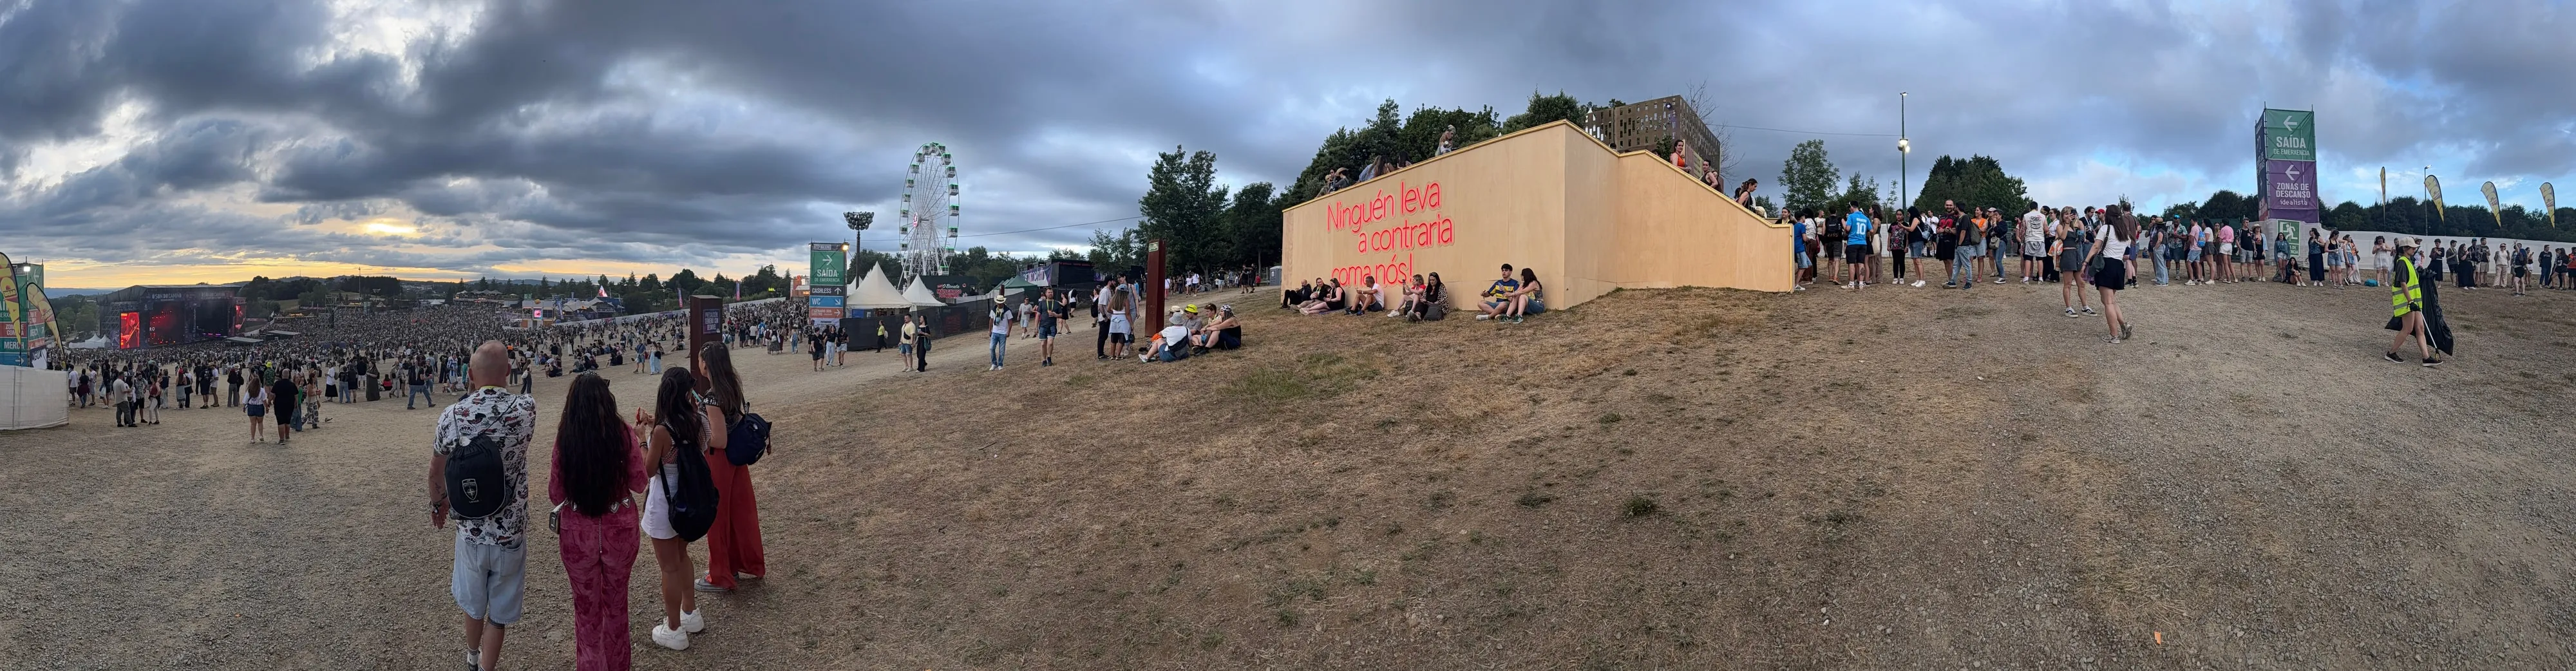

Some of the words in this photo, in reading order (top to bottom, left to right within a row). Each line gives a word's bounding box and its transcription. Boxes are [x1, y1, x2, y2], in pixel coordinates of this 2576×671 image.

[2276, 135, 2306, 148] SAÍDA
[2277, 183, 2298, 191] ZONAS
[1327, 189, 1395, 233] Ninguén
[1400, 180, 1441, 216] leva
[1358, 232, 1367, 254] a
[1370, 213, 1453, 251] contraria
[1856, 222, 1866, 235] 10
[817, 268, 838, 277] SAÍDA
[1331, 263, 1371, 286] coma
[1376, 253, 1413, 285] nós!
[32, 349, 42, 361] AGUA
